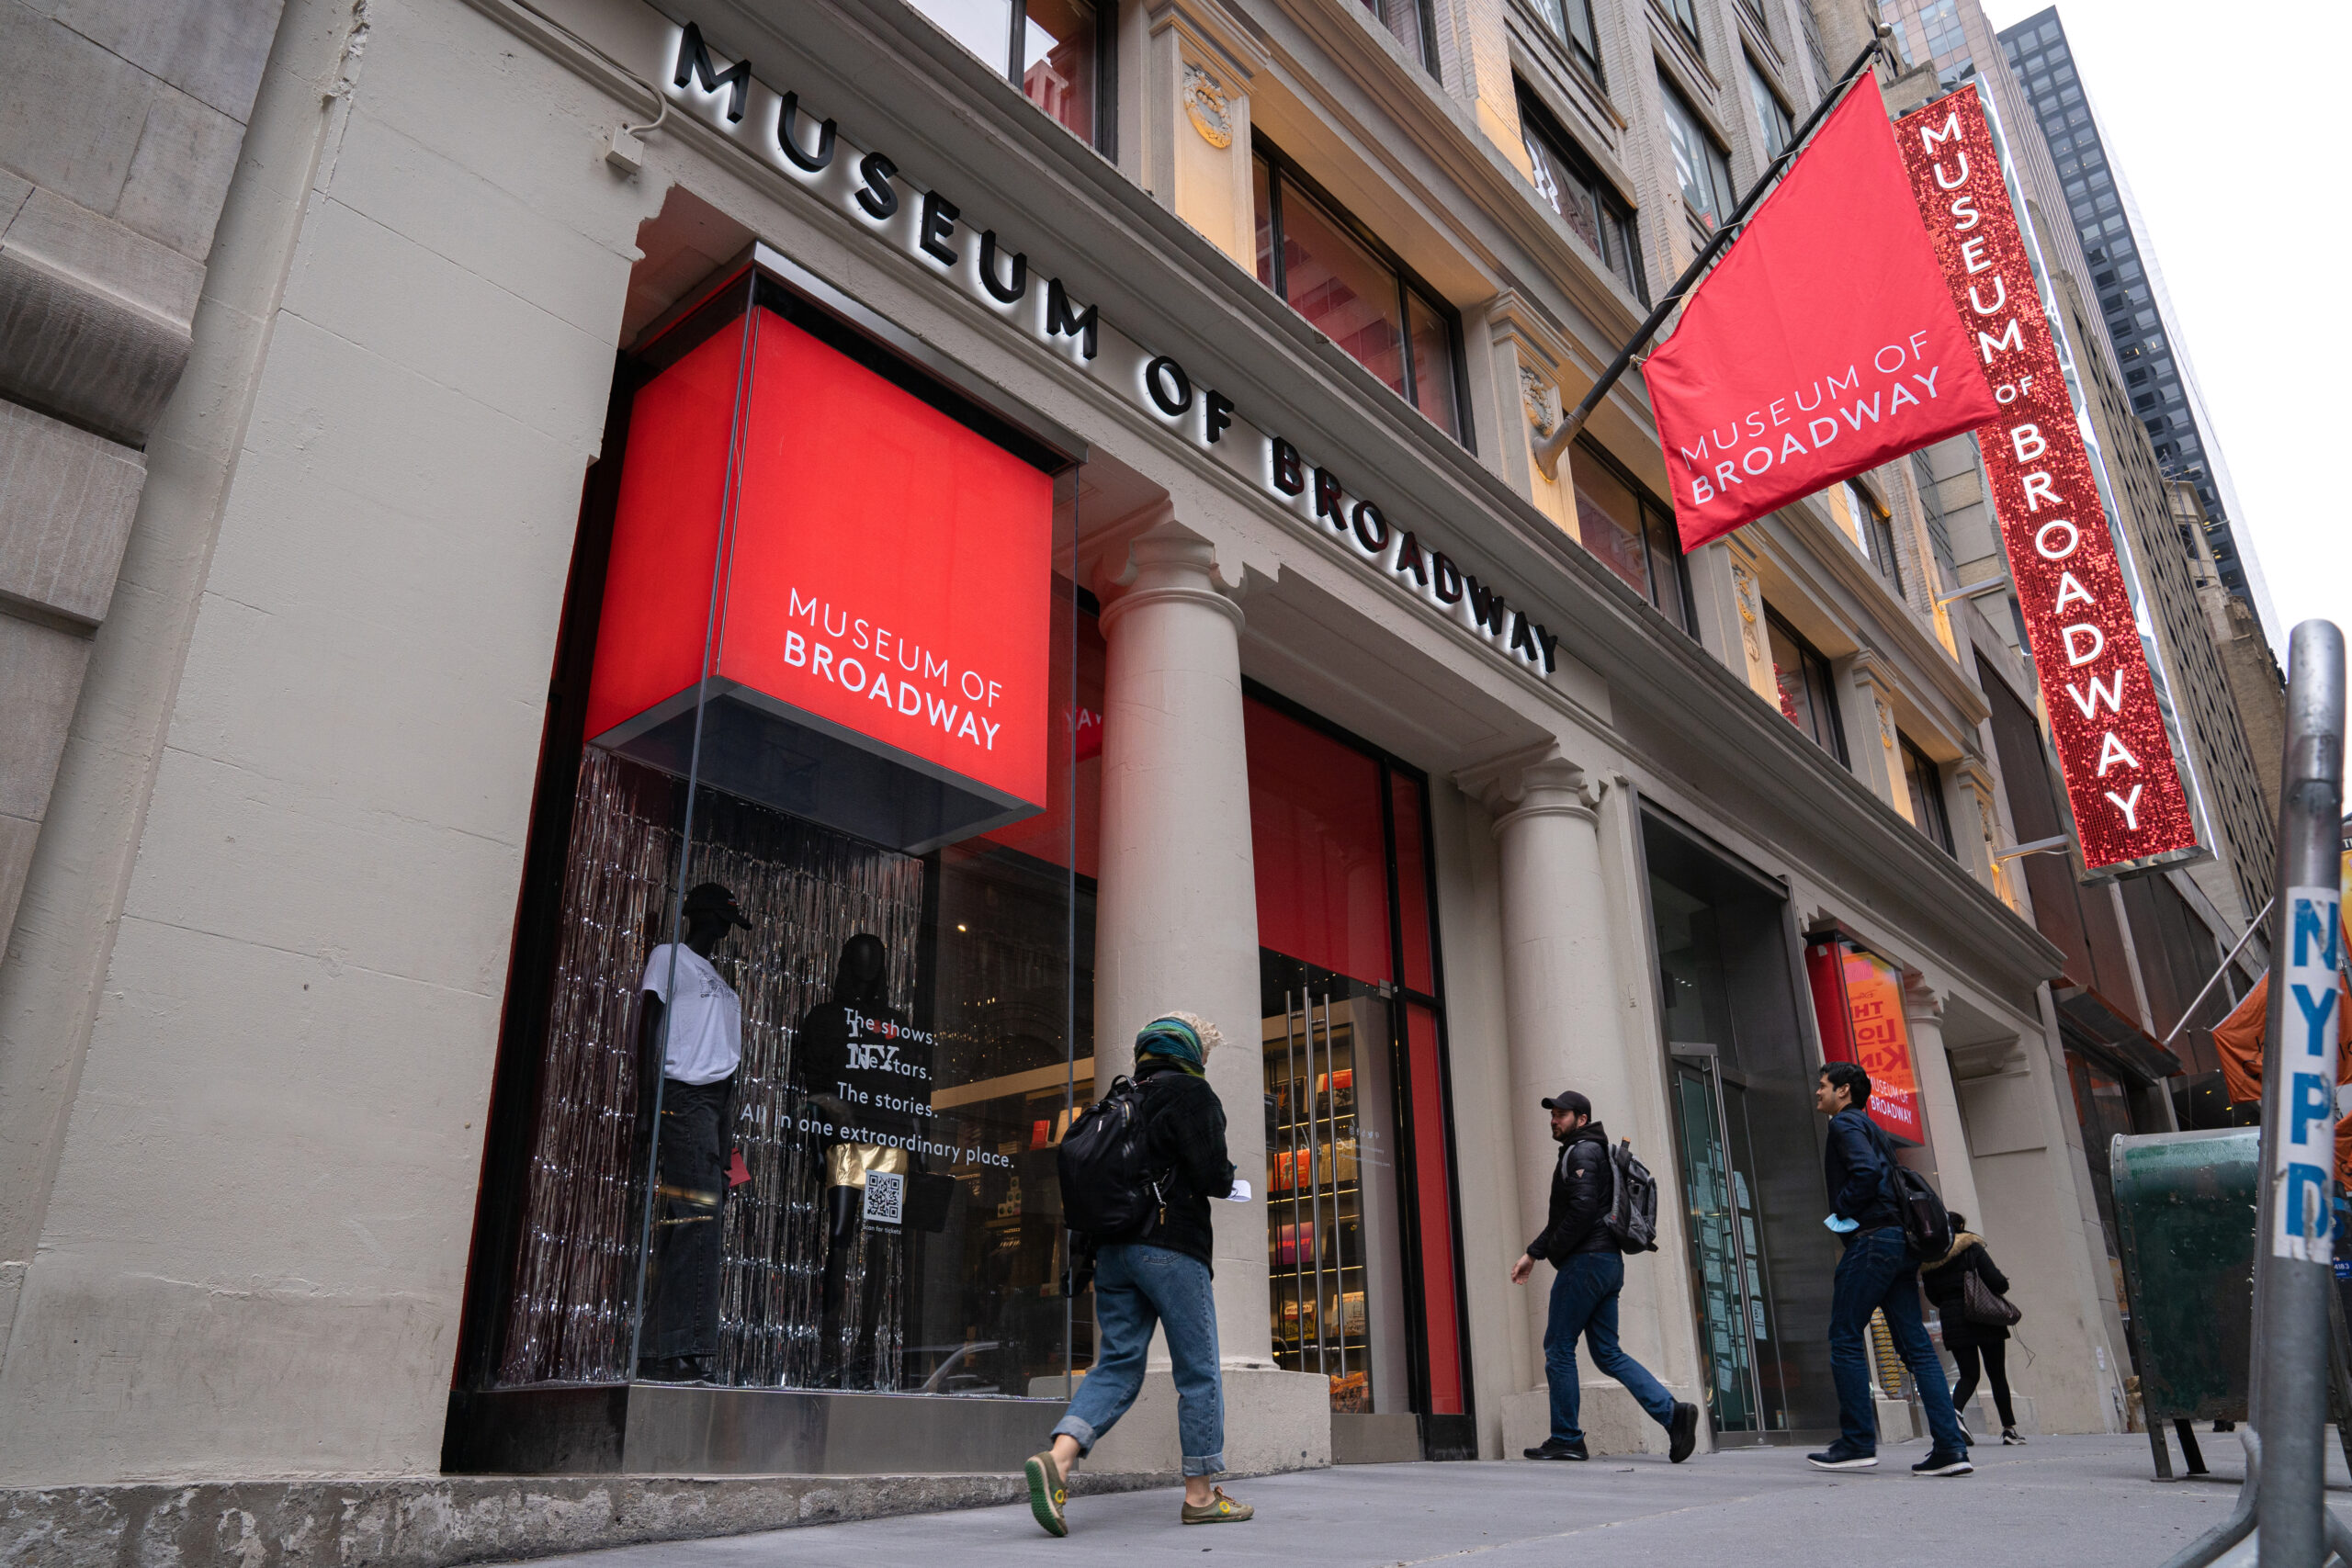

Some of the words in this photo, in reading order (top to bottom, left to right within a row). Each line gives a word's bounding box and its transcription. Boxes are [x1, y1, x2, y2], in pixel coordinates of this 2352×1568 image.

[1920, 111, 2024, 364] MUSEUM
[674, 21, 1098, 361] MUSEUM
[1146, 355, 1234, 444] OF
[1272, 435, 1559, 674] BROADWAY
[1680, 365, 1860, 470] MUSEUM
[1874, 330, 1928, 373] OF
[1996, 376, 2033, 404] OF
[1691, 366, 1939, 505] BROADWAY
[789, 587, 948, 687] MUSEUM
[961, 671, 1002, 707] OF
[2010, 423, 2143, 830] BROADWAY
[784, 630, 1001, 750] BROADWAY
[844, 1007, 875, 1031] The
[881, 1019, 938, 1046] shows.
[2286, 898, 2338, 1238] NYPD
[741, 1102, 767, 1124] All
[775, 1111, 791, 1128] in
[799, 1119, 833, 1136] one
[840, 1126, 961, 1163] extraordinary
[967, 1148, 1014, 1168] place.
[838, 1081, 868, 1104] The
[875, 1093, 938, 1118] stories.
[1871, 1094, 1912, 1124] BROADWAY
[1899, 1089, 1908, 1104] OF
